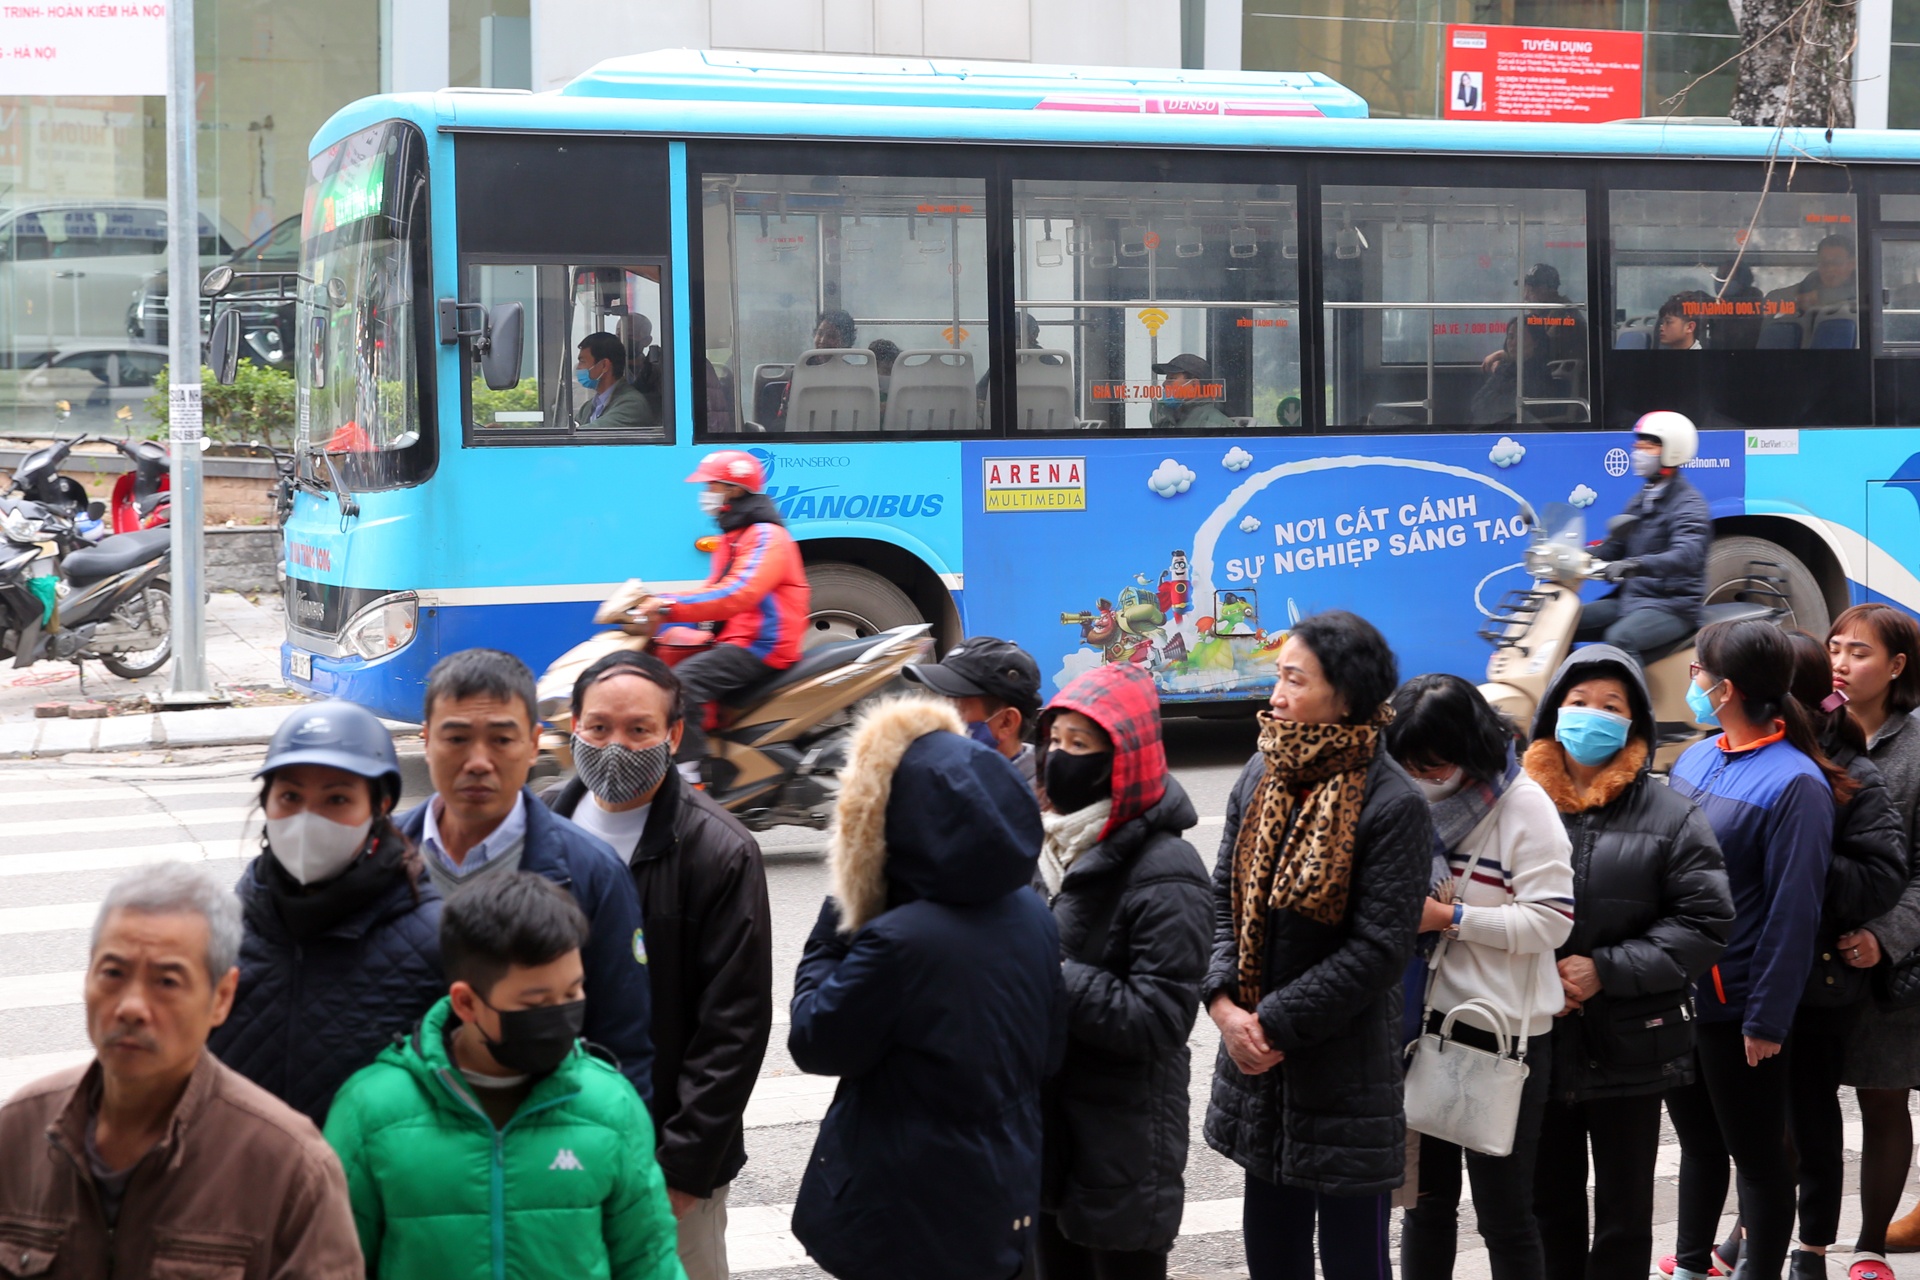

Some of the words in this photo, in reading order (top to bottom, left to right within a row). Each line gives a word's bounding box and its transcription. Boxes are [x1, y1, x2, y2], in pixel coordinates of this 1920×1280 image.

[1560, 40, 1593, 54] DỤNG
[1168, 99, 1216, 112] DENSO
[1133, 385, 1162, 399] 7.000
[777, 456, 850, 468] TRANSERCO
[989, 463, 1081, 484] ARENA
[767, 485, 944, 519] HANOIBUS
[988, 492, 1082, 508] MULTIMEDIA
[1274, 516, 1326, 546] NƠI
[1335, 506, 1389, 535] CẤT
[1398, 494, 1478, 526] CÁNH
[1225, 554, 1265, 584] SỰ
[1273, 537, 1381, 575] NGHIỆP
[1389, 525, 1467, 557] SÁNG
[1473, 515, 1529, 545] TẠO
